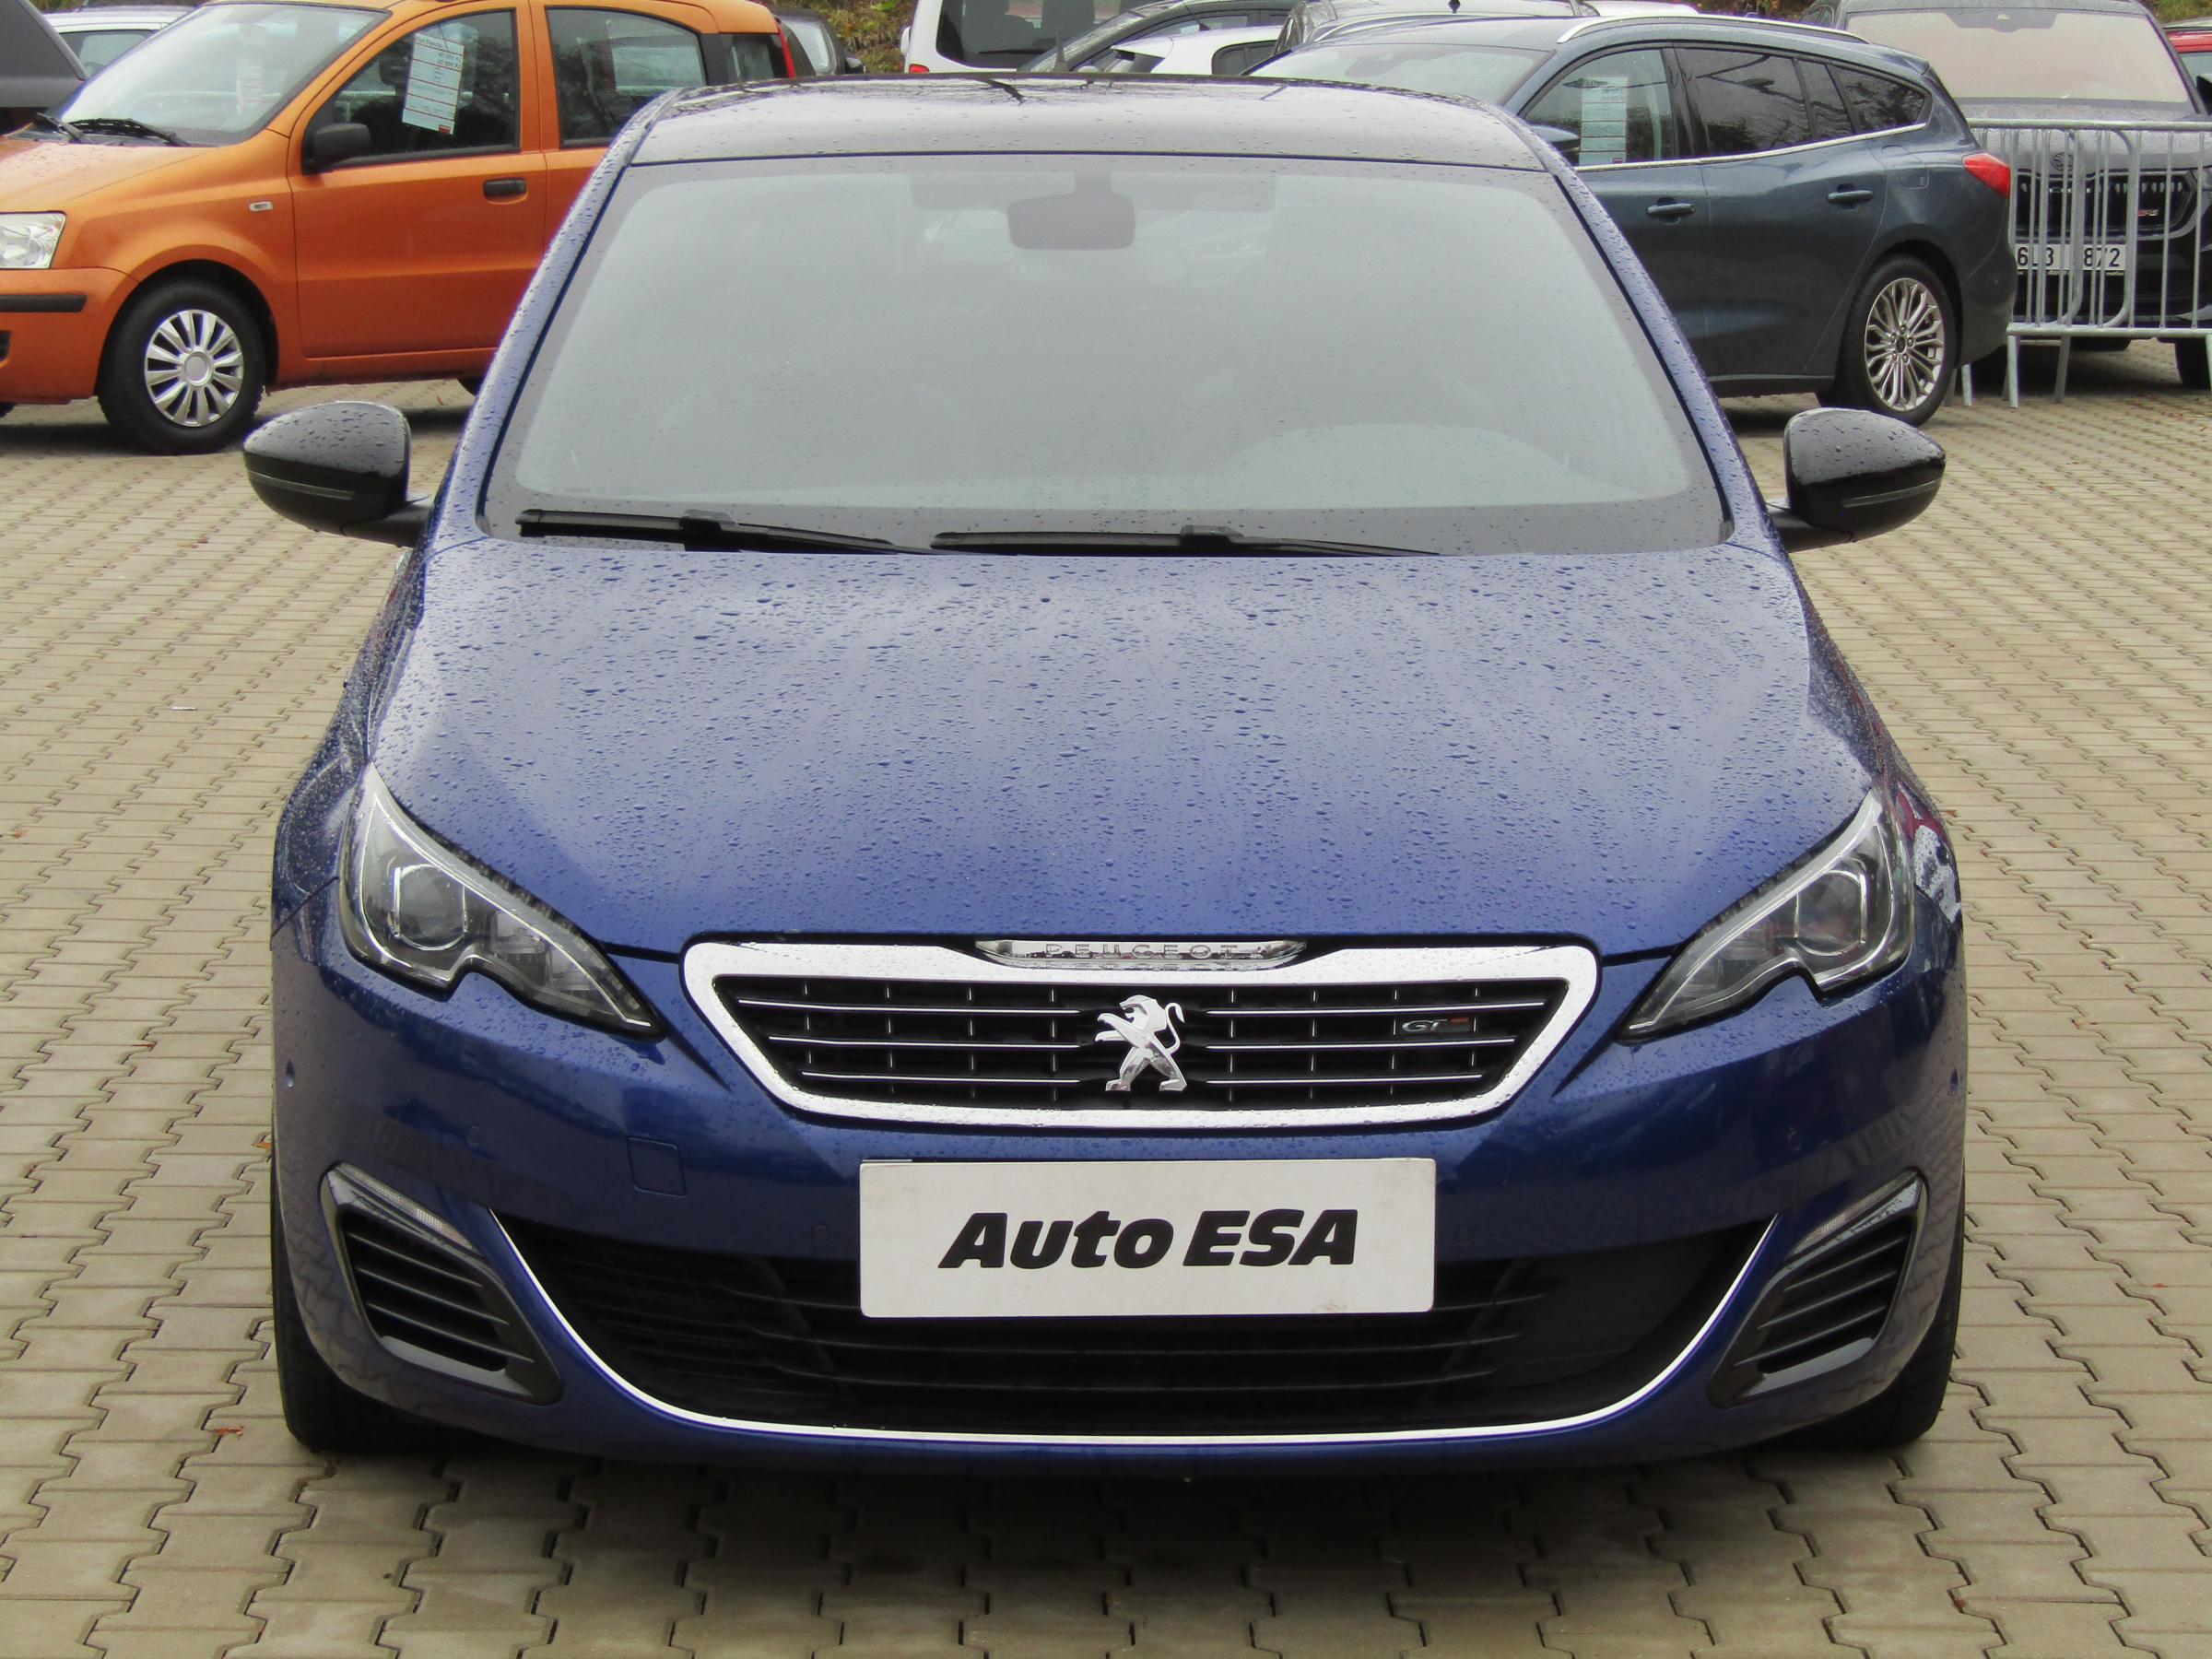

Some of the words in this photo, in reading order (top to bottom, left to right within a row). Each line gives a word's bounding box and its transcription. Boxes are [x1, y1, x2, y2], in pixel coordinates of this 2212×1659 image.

[1045, 943, 1239, 960] PEUGEOT
[1401, 1018, 1448, 1032] GT
[937, 1210, 1174, 1270] Auto
[1182, 1208, 1359, 1267] ESA
